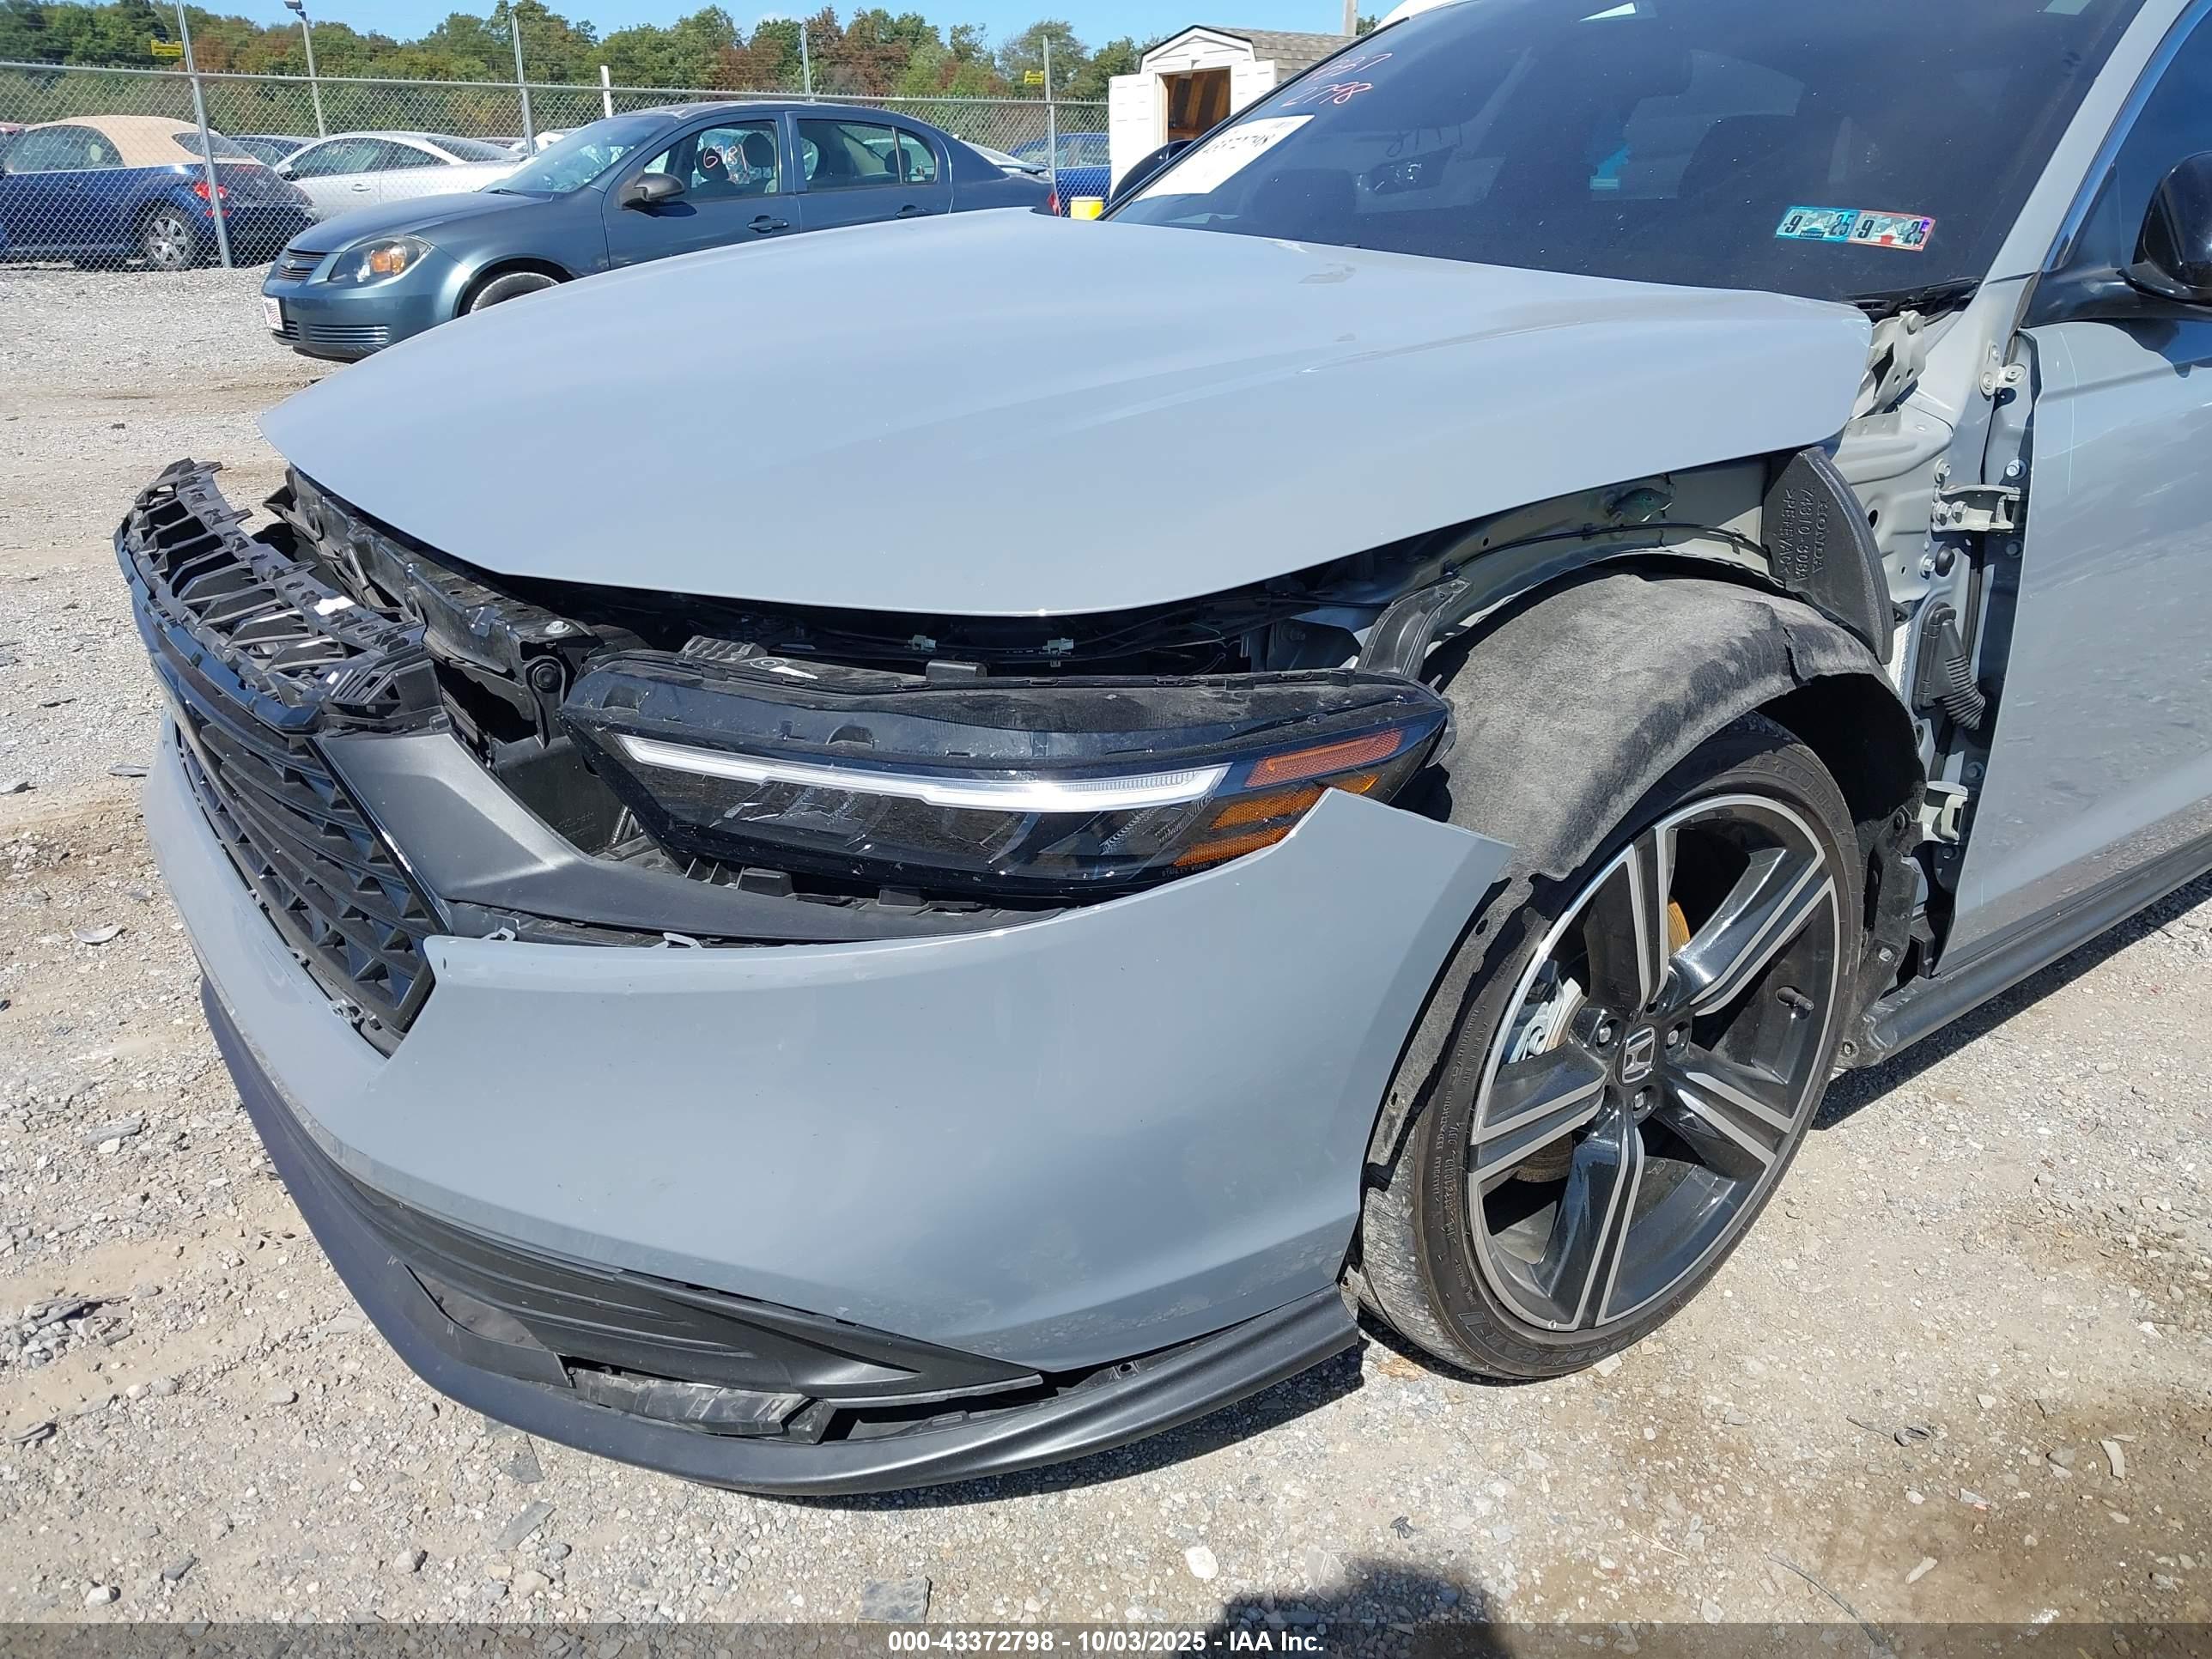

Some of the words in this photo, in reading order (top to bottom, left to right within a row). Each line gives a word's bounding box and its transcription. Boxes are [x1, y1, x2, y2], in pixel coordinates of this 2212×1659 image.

[1279, 81, 1374, 108] 2798
[1784, 215, 1803, 234] 9
[1828, 214, 1855, 236] 25
[1856, 219, 1875, 239] 9
[1903, 220, 1930, 245] 25
